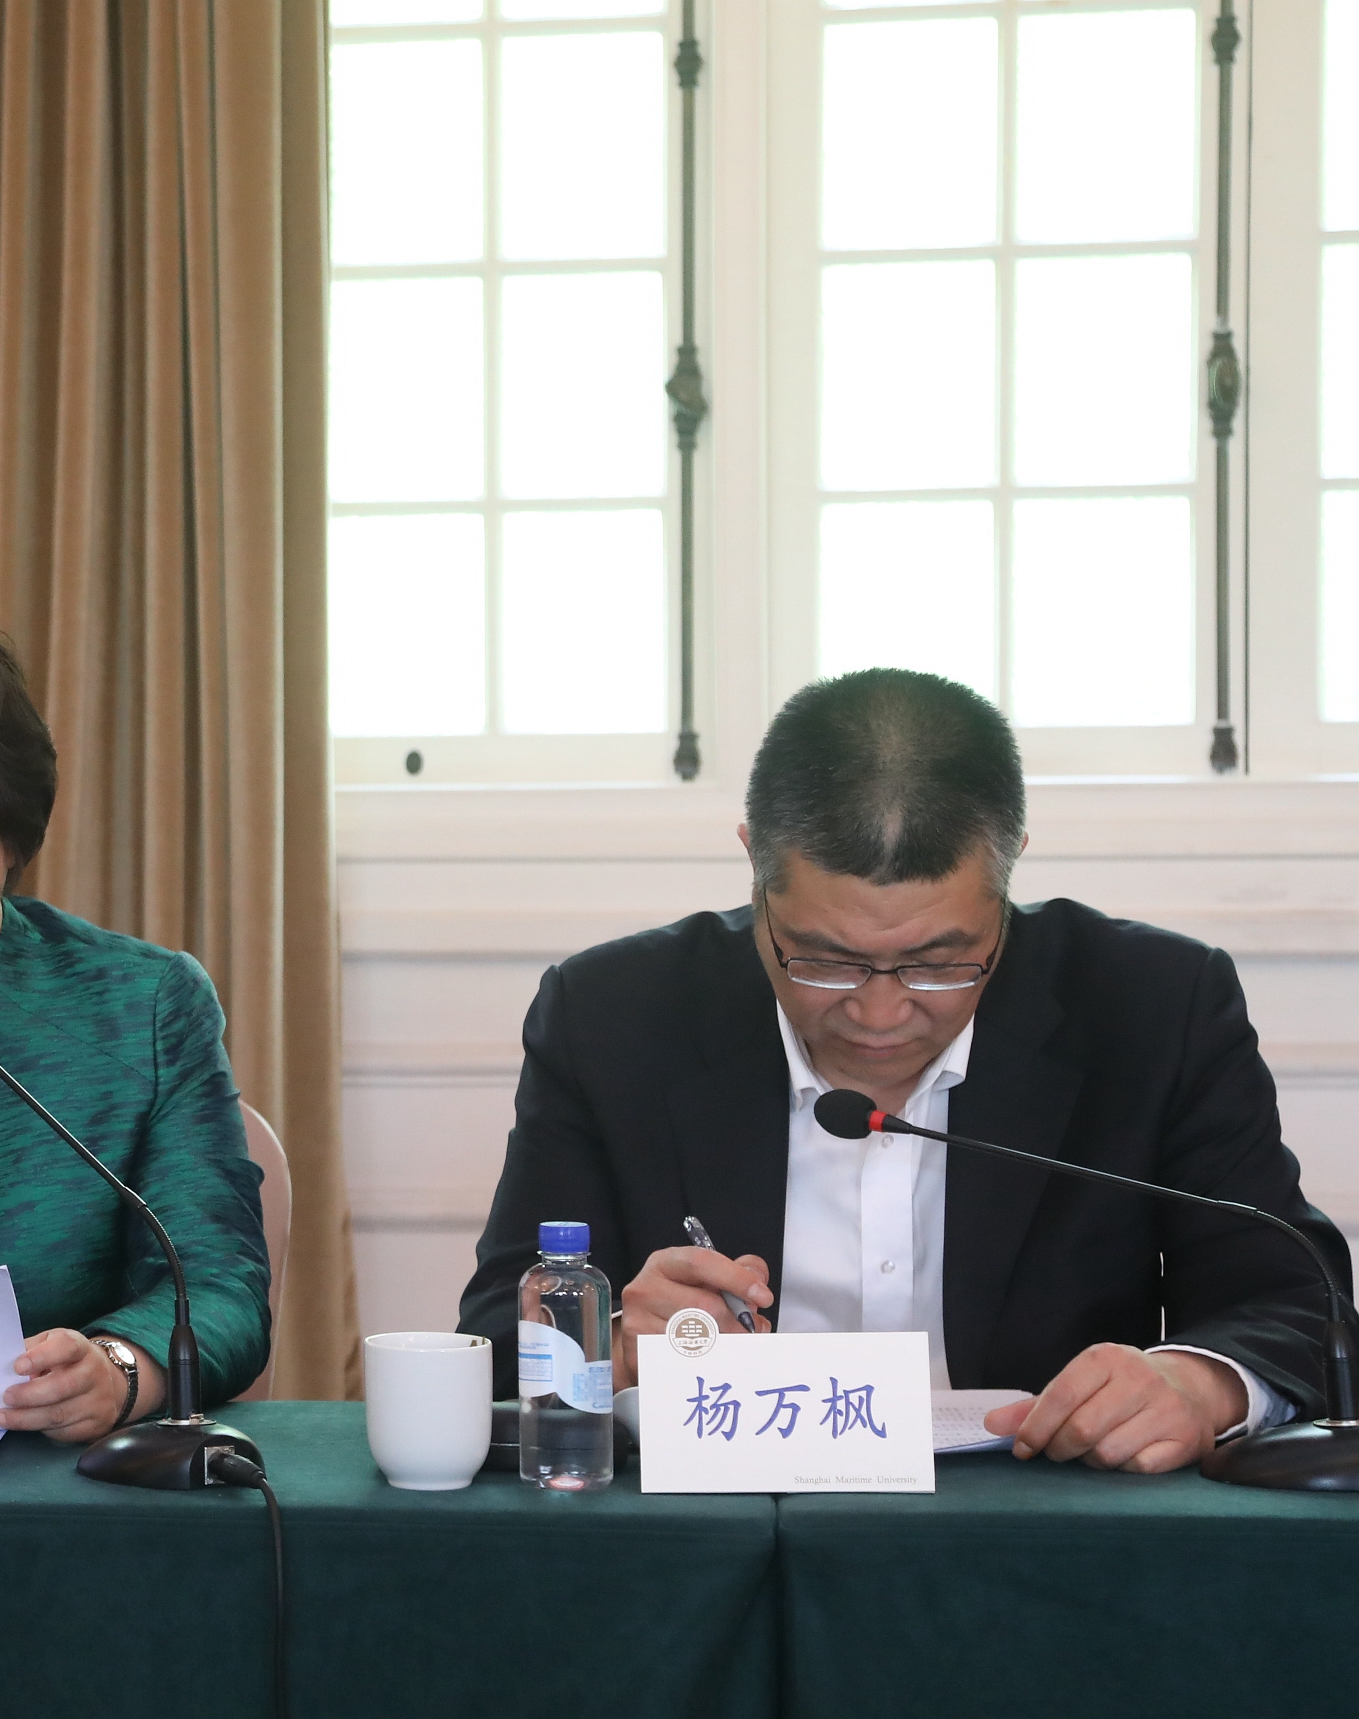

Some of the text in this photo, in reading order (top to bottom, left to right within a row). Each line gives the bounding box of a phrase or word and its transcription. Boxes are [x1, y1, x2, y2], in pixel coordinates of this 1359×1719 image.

[684, 1377, 887, 1441] 杨万枫
[794, 1476, 917, 1485] Shanghai Maritime University
